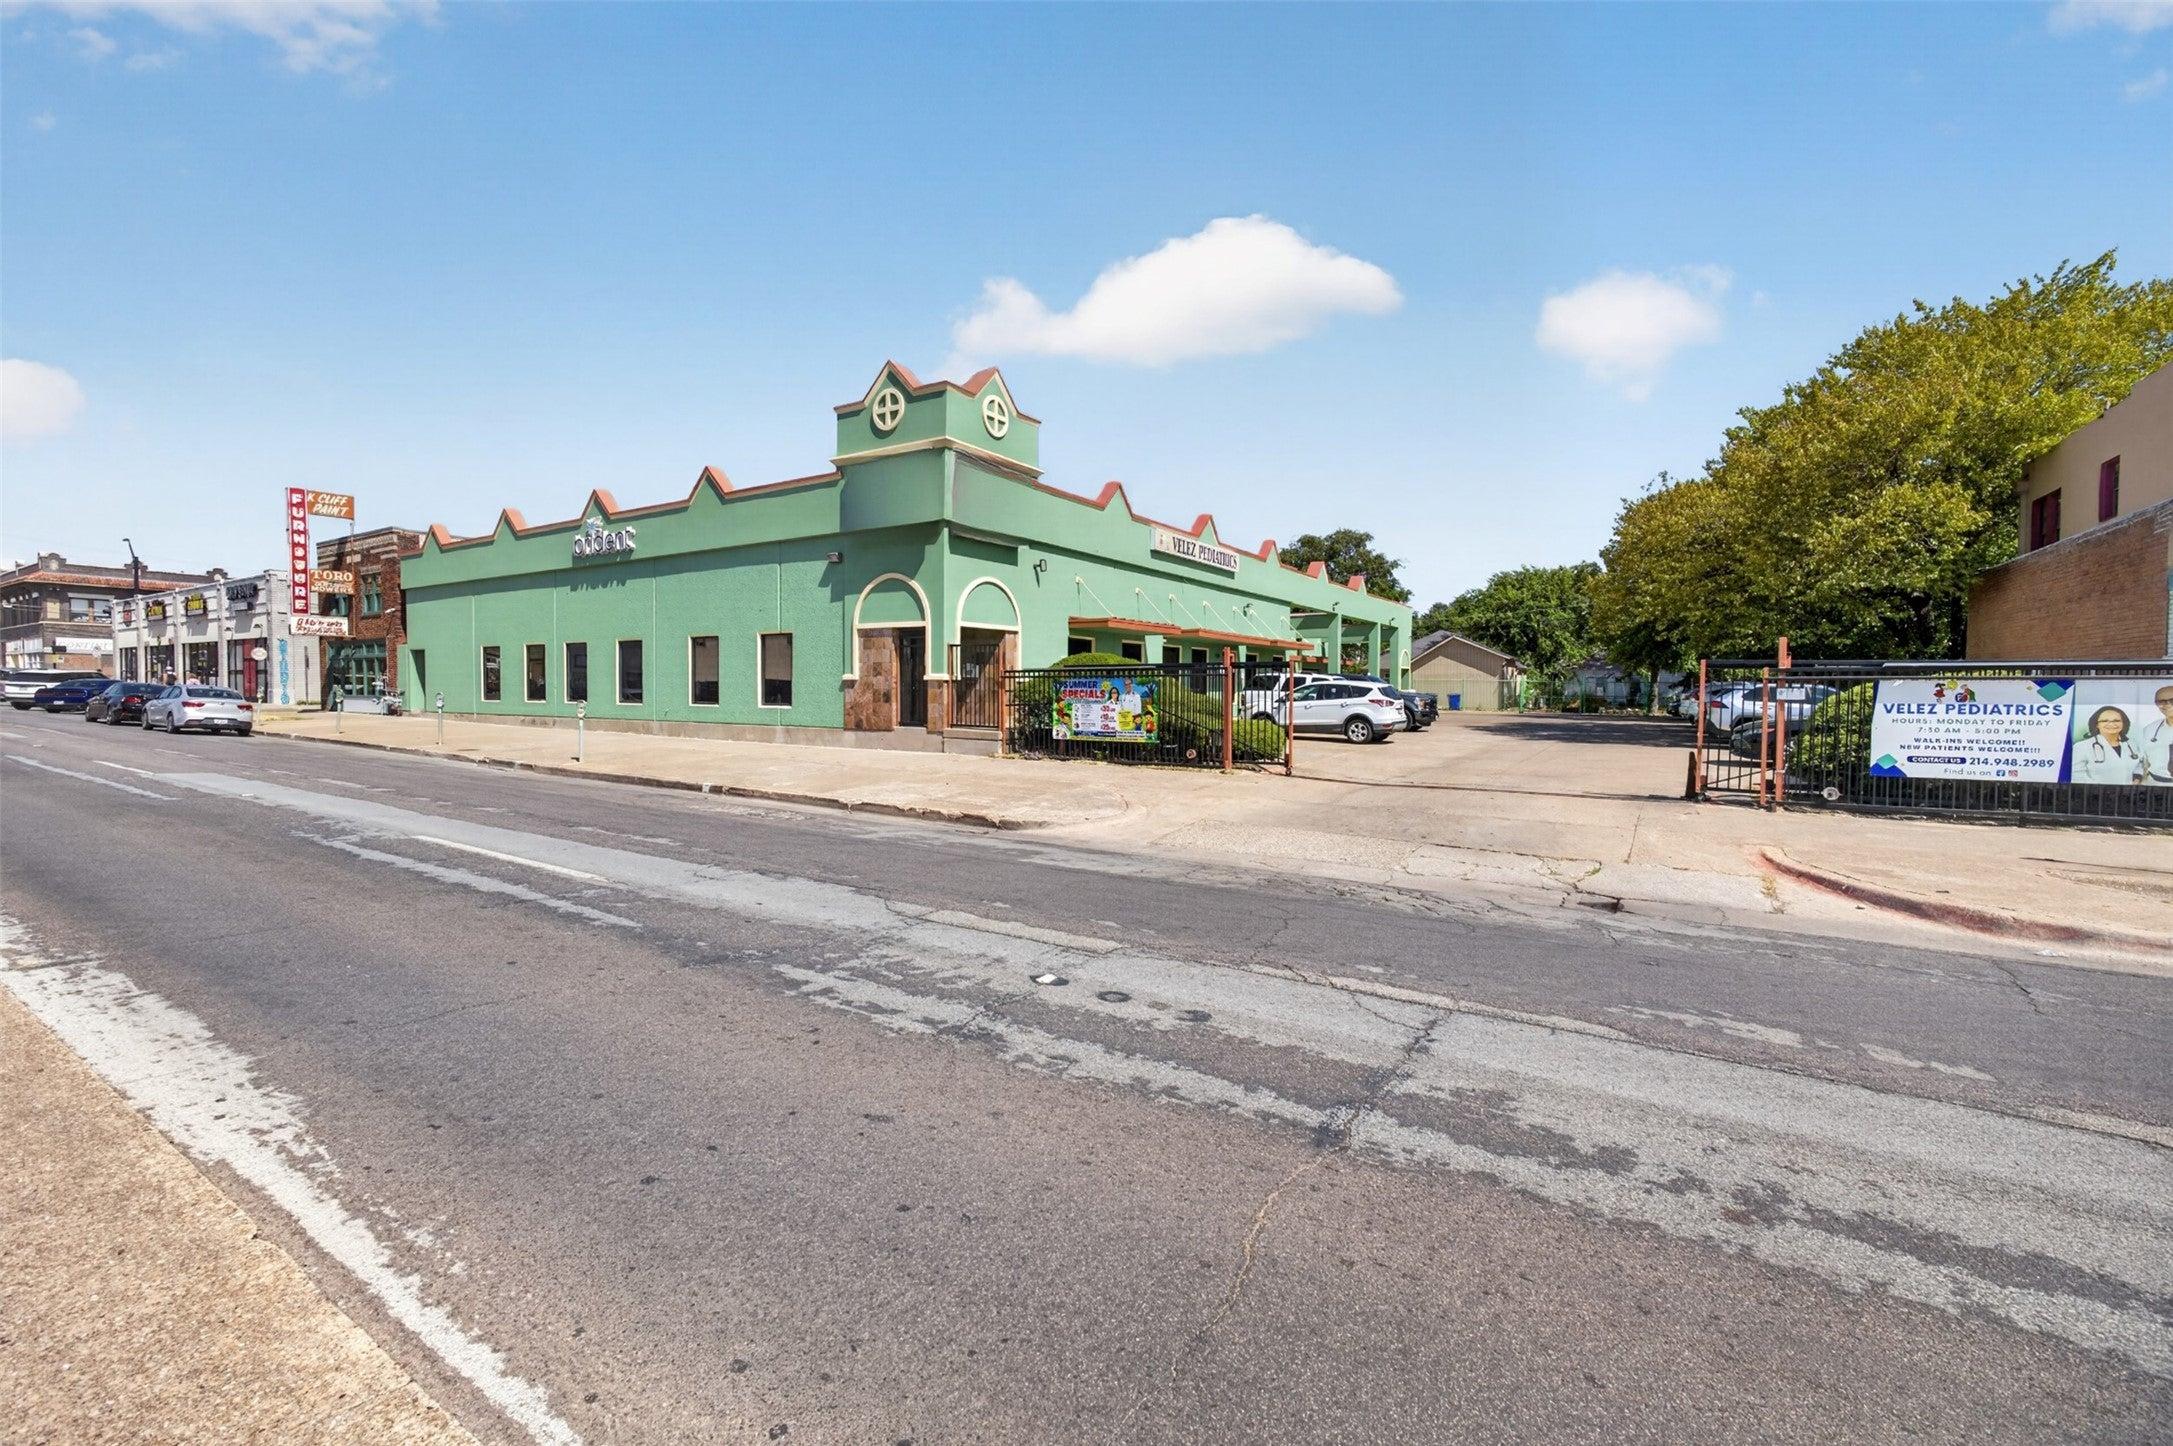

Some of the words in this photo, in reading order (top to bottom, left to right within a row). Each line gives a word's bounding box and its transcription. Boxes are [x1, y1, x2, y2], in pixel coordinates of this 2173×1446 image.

[317, 493, 348, 506] CLIFF
[312, 503, 350, 517] PAINT
[1172, 536, 1196, 558] VELEZ
[1198, 545, 1238, 569] PEDIATRICS
[310, 570, 353, 582] TORO
[1063, 680, 1098, 689] SUMMER
[1062, 689, 1106, 699] SPECIALS
[1883, 703, 1937, 715] VELEZ
[1945, 703, 2063, 716] PEDIATRICS
[2009, 719, 2051, 727] FRIDAY
[1966, 738, 2026, 746] WELCOME!!
[1969, 757, 2055, 768] 214.948.2989
